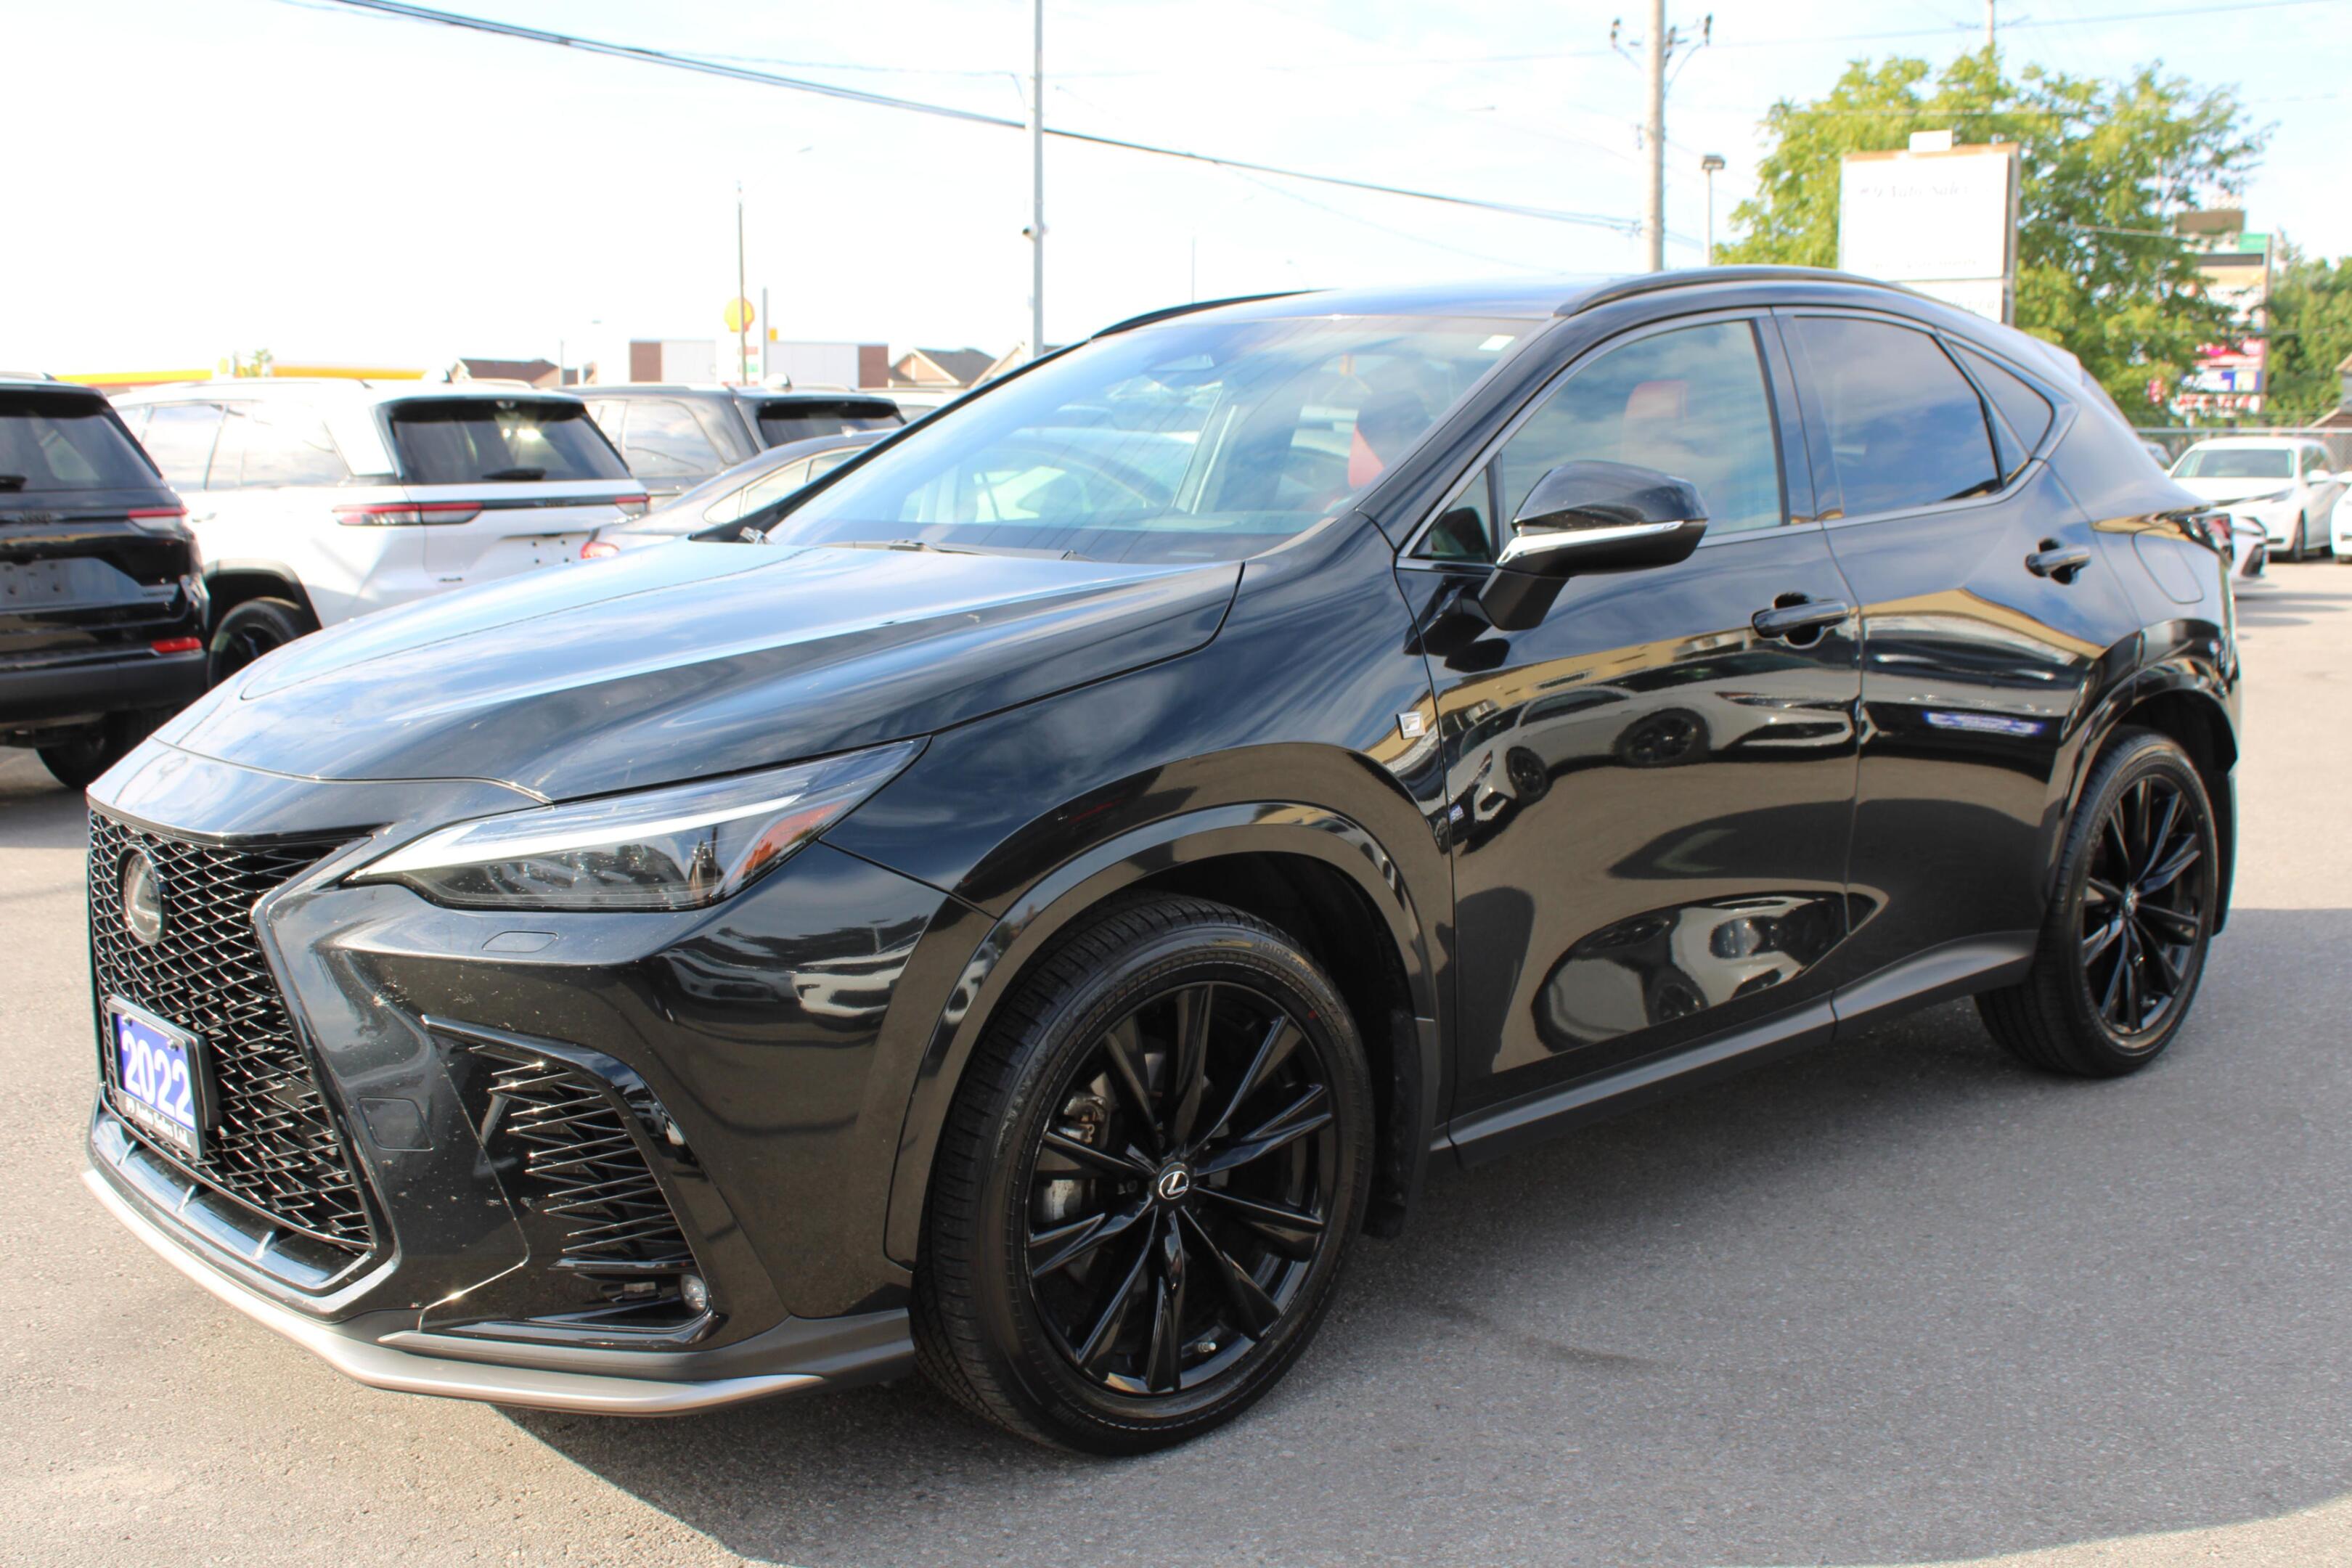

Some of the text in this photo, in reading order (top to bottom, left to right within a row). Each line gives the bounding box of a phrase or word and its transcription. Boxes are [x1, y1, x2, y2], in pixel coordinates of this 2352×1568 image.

[121, 1029, 195, 1129] 2022
[135, 1102, 153, 1125] Auto
[153, 1111, 173, 1138] Sales
